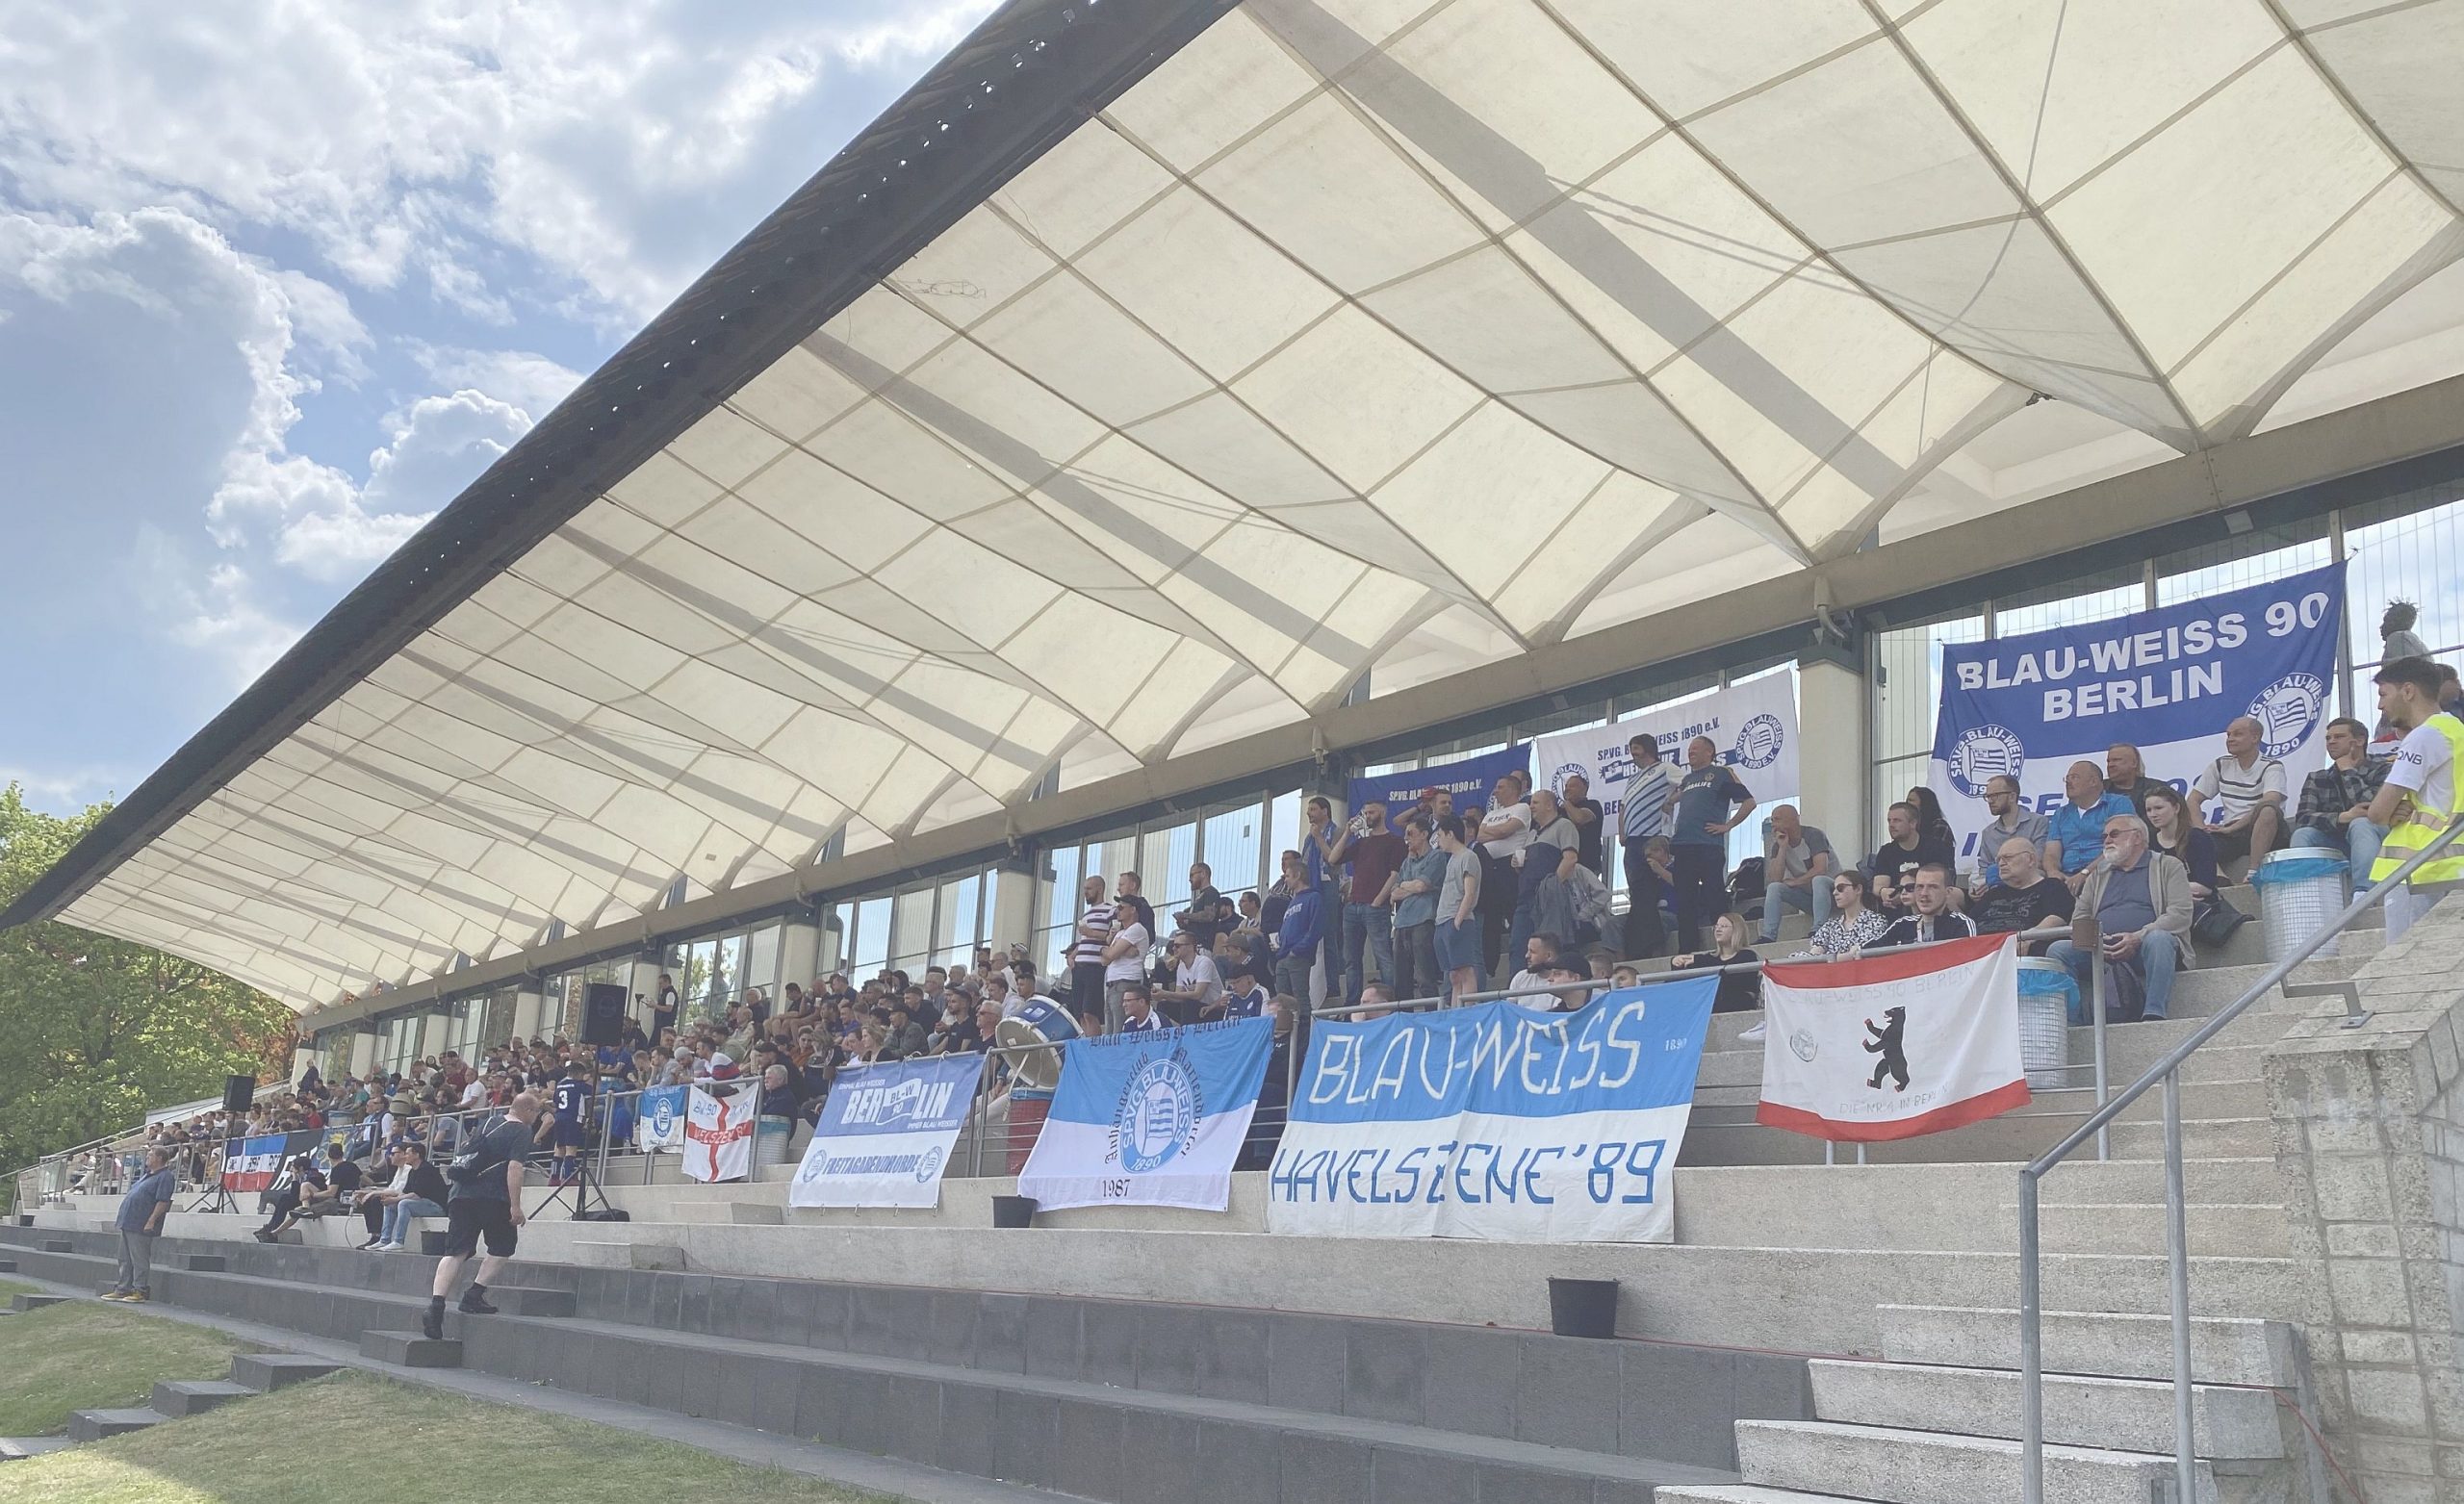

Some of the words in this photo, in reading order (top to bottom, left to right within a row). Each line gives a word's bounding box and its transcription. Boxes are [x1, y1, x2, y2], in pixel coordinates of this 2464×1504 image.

[1957, 613, 2248, 690] BLAU-WEISS
[2265, 592, 2330, 637] 90
[2043, 661, 2223, 723] BERLIN
[1681, 723, 1703, 740] 1890
[2265, 737, 2300, 756] 1890
[1451, 781, 1469, 793] 1890
[1968, 784, 1987, 795] 189
[1308, 1000, 1646, 1105] BLAU-WEISS
[558, 1090, 568, 1109] 3
[1131, 1155, 1162, 1171] 1890
[1101, 1178, 1131, 1198] 1987
